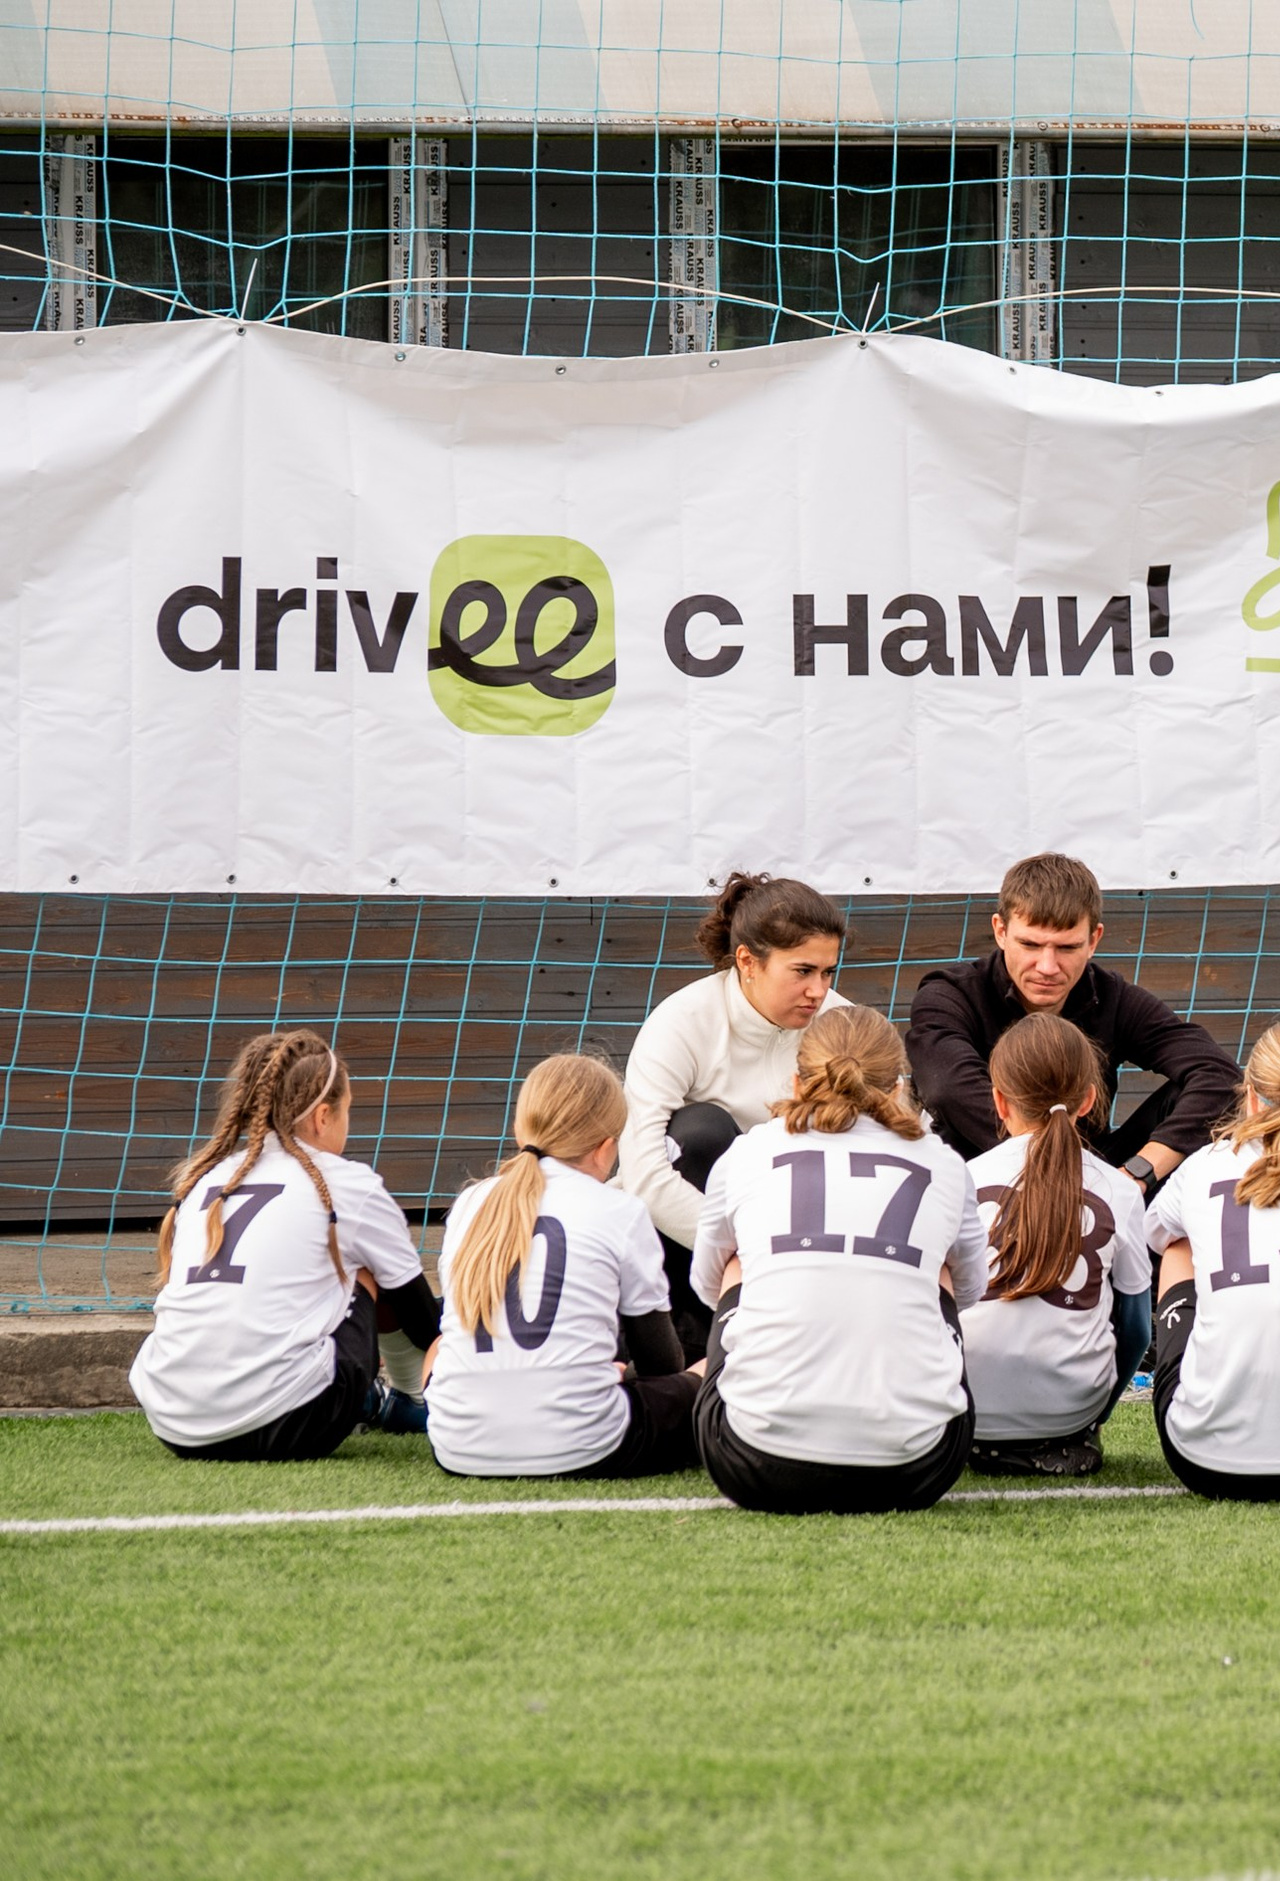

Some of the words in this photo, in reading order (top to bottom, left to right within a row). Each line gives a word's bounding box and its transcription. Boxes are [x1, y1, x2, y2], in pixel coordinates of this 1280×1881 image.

[675, 181, 683, 230] KRAUSS
[695, 157, 703, 206] KRAUSS
[1039, 182, 1047, 231] KRAUSS
[157, 556, 617, 701] drivee
[664, 594, 744, 678] с
[793, 564, 1173, 677] нами!
[186, 1182, 286, 1285] 7
[771, 1149, 932, 1269] 17
